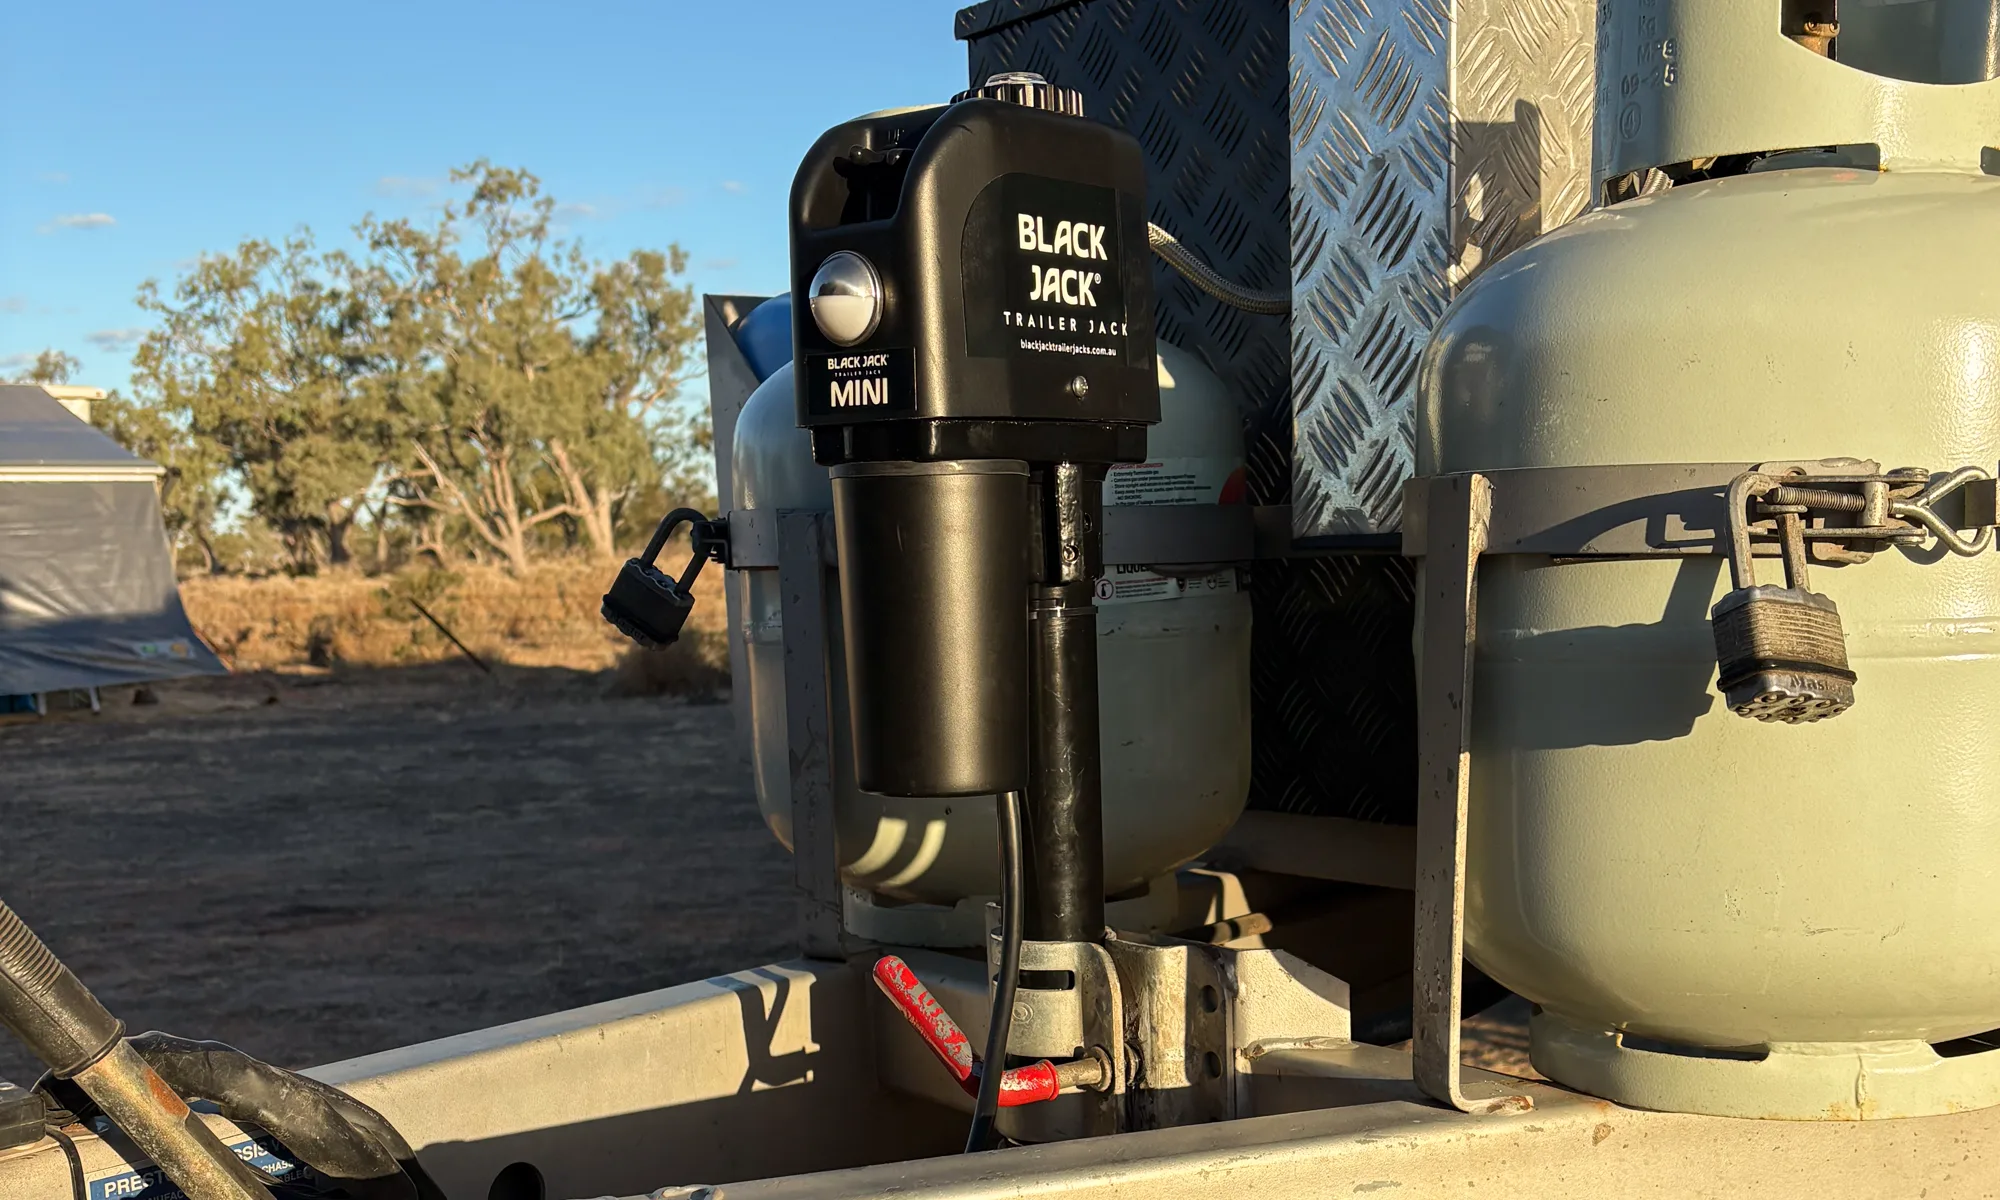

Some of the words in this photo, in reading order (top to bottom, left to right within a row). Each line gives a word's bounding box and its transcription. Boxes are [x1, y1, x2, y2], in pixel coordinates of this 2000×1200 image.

[1018, 213, 1108, 261] BLACK
[1003, 311, 1077, 332] TRAILER
[1089, 322, 1128, 337] JACK
[1020, 339, 1117, 356] blackjacktrailerjacks.com.au
[827, 356, 860, 370] BLACK
[830, 377, 888, 408] MINI
